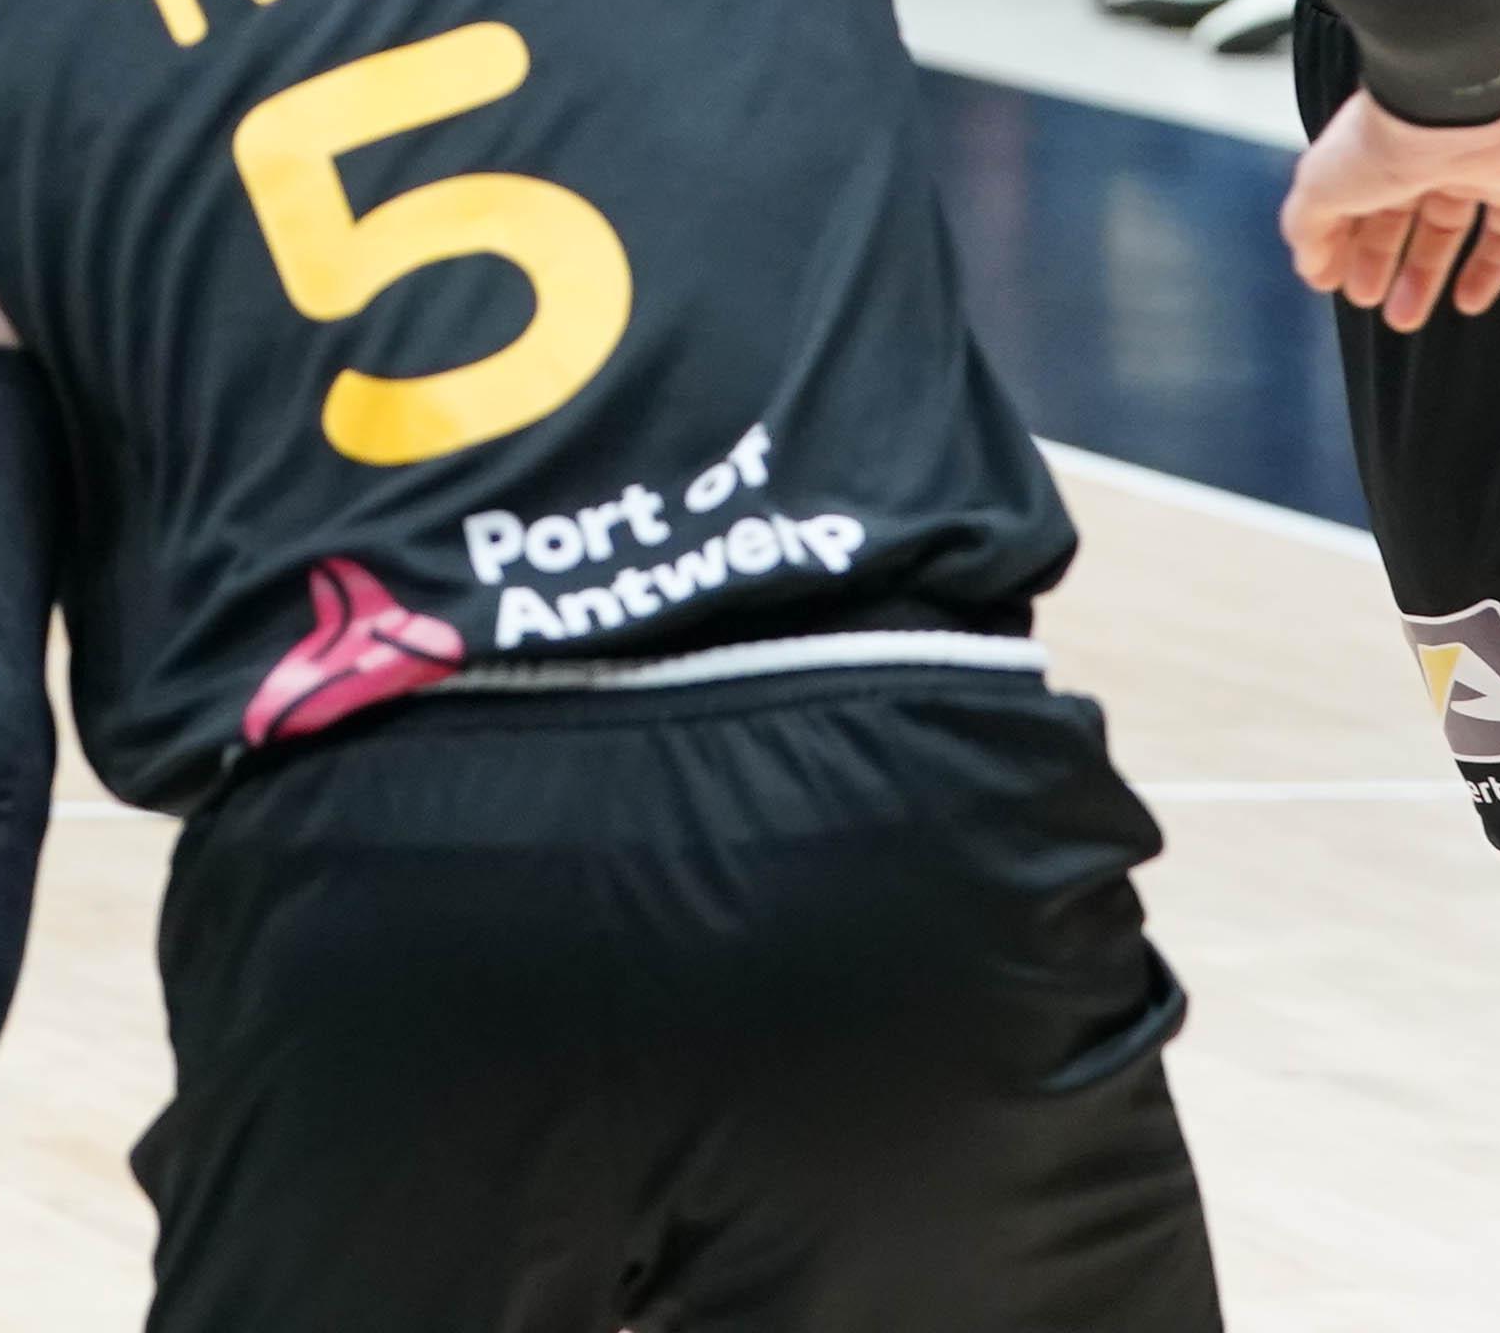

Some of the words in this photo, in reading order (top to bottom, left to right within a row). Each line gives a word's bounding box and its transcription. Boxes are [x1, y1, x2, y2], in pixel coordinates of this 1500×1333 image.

[232, 20, 634, 467] 5
[462, 483, 671, 586] Port
[494, 512, 867, 650] Antwerp
